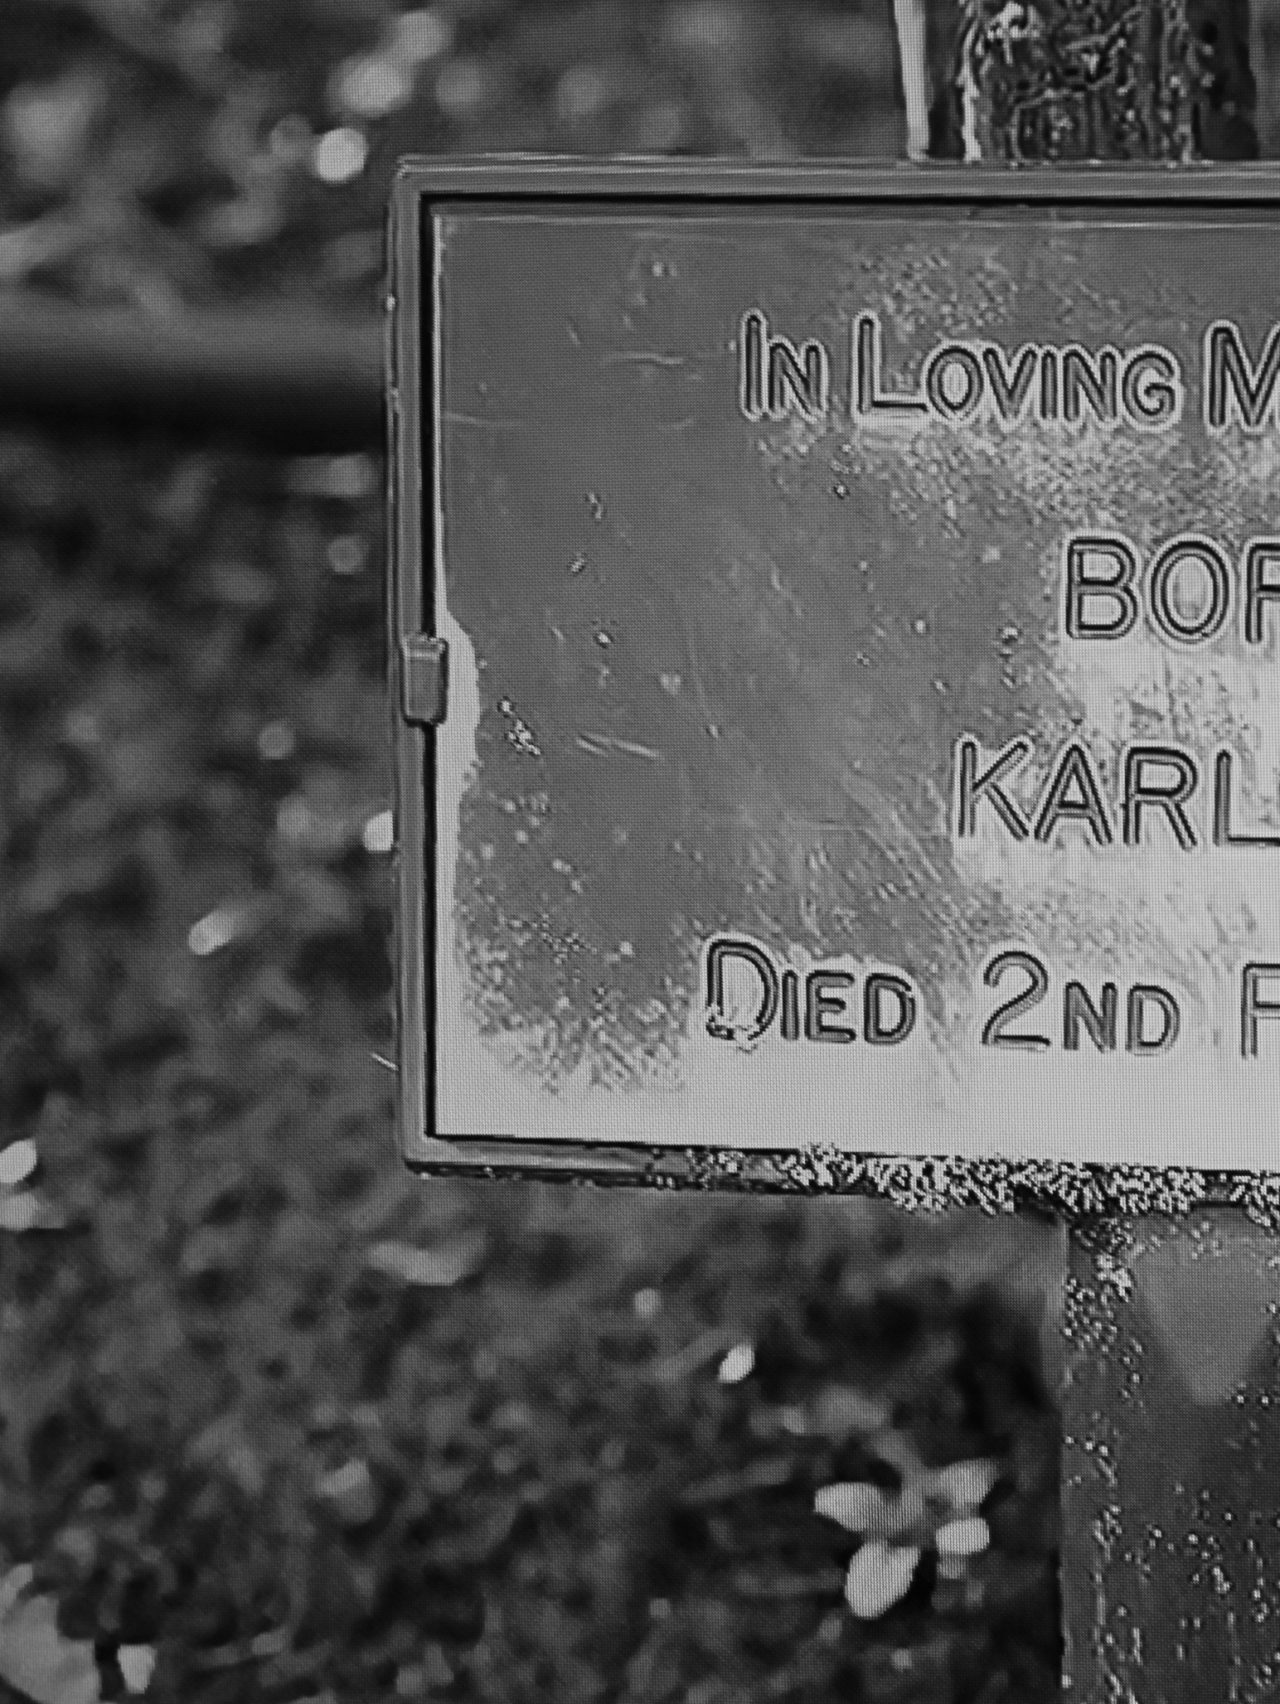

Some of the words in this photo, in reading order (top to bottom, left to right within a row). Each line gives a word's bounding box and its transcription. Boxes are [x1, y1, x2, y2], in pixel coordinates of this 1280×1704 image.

[744, 312, 827, 419] IN
[854, 313, 1178, 427] LOVING
[705, 938, 917, 1048] DIED
[981, 950, 1181, 1055] 2ND
